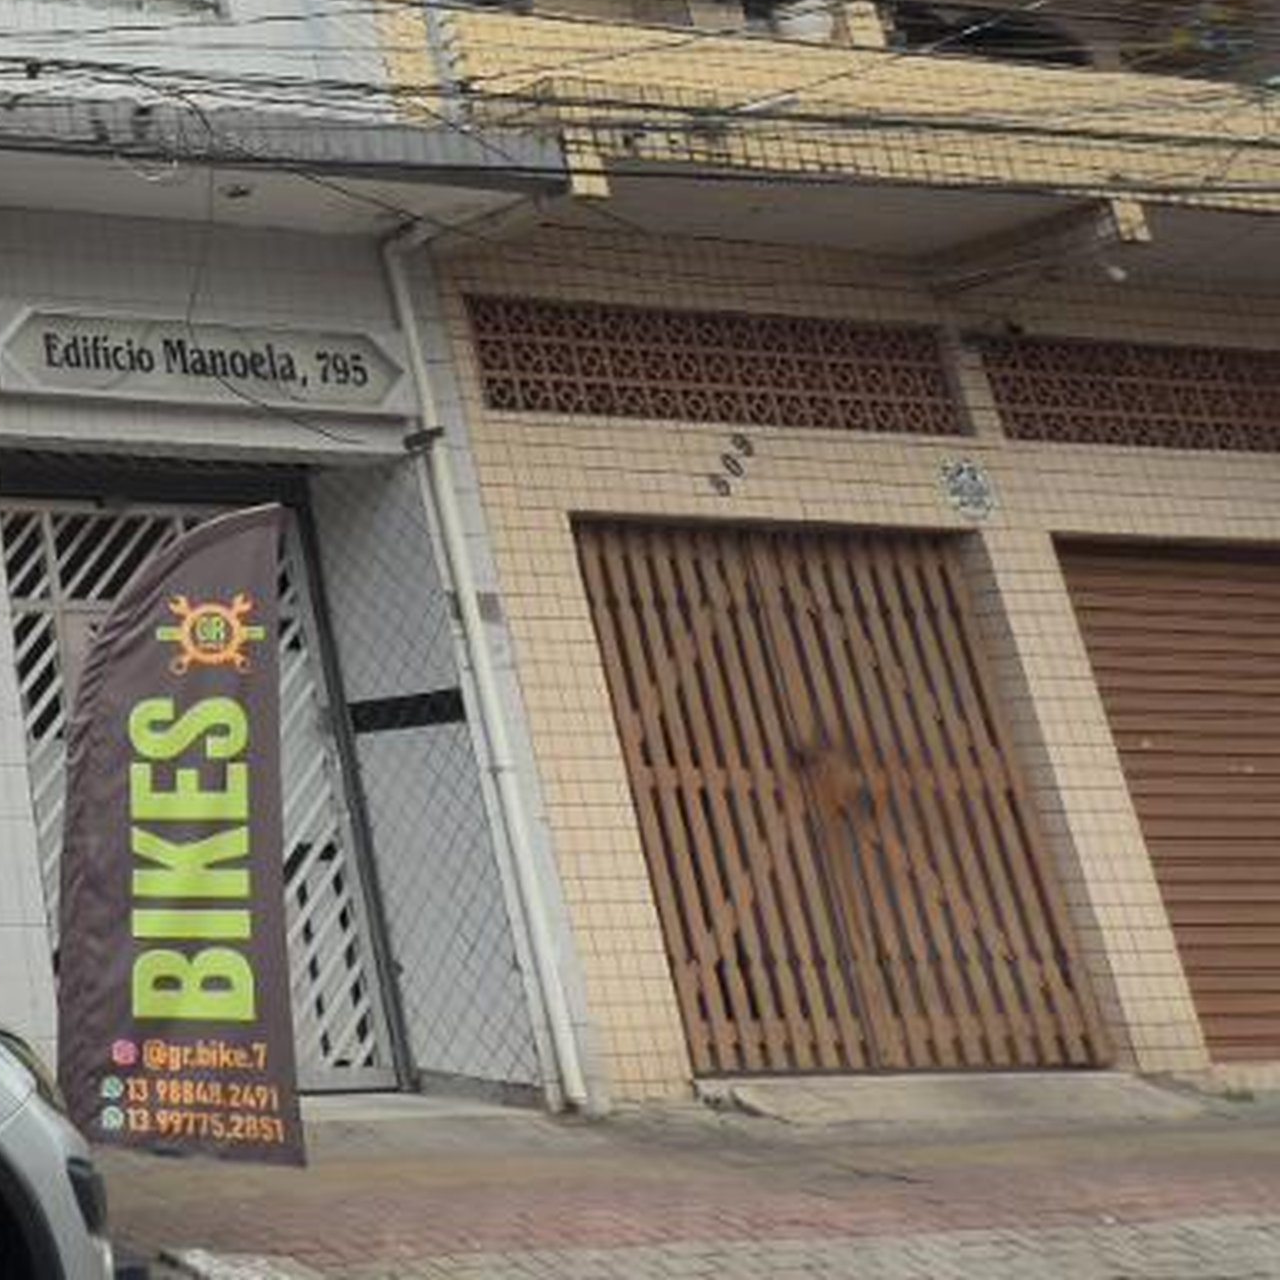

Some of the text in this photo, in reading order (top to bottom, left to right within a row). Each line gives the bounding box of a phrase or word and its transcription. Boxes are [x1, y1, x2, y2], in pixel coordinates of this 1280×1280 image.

[316, 351, 368, 387] 795
[196, 617, 225, 640] GR
[128, 696, 256, 1020] BIKES
[126, 1077, 149, 1102] 13
[126, 1107, 149, 1131] 13
